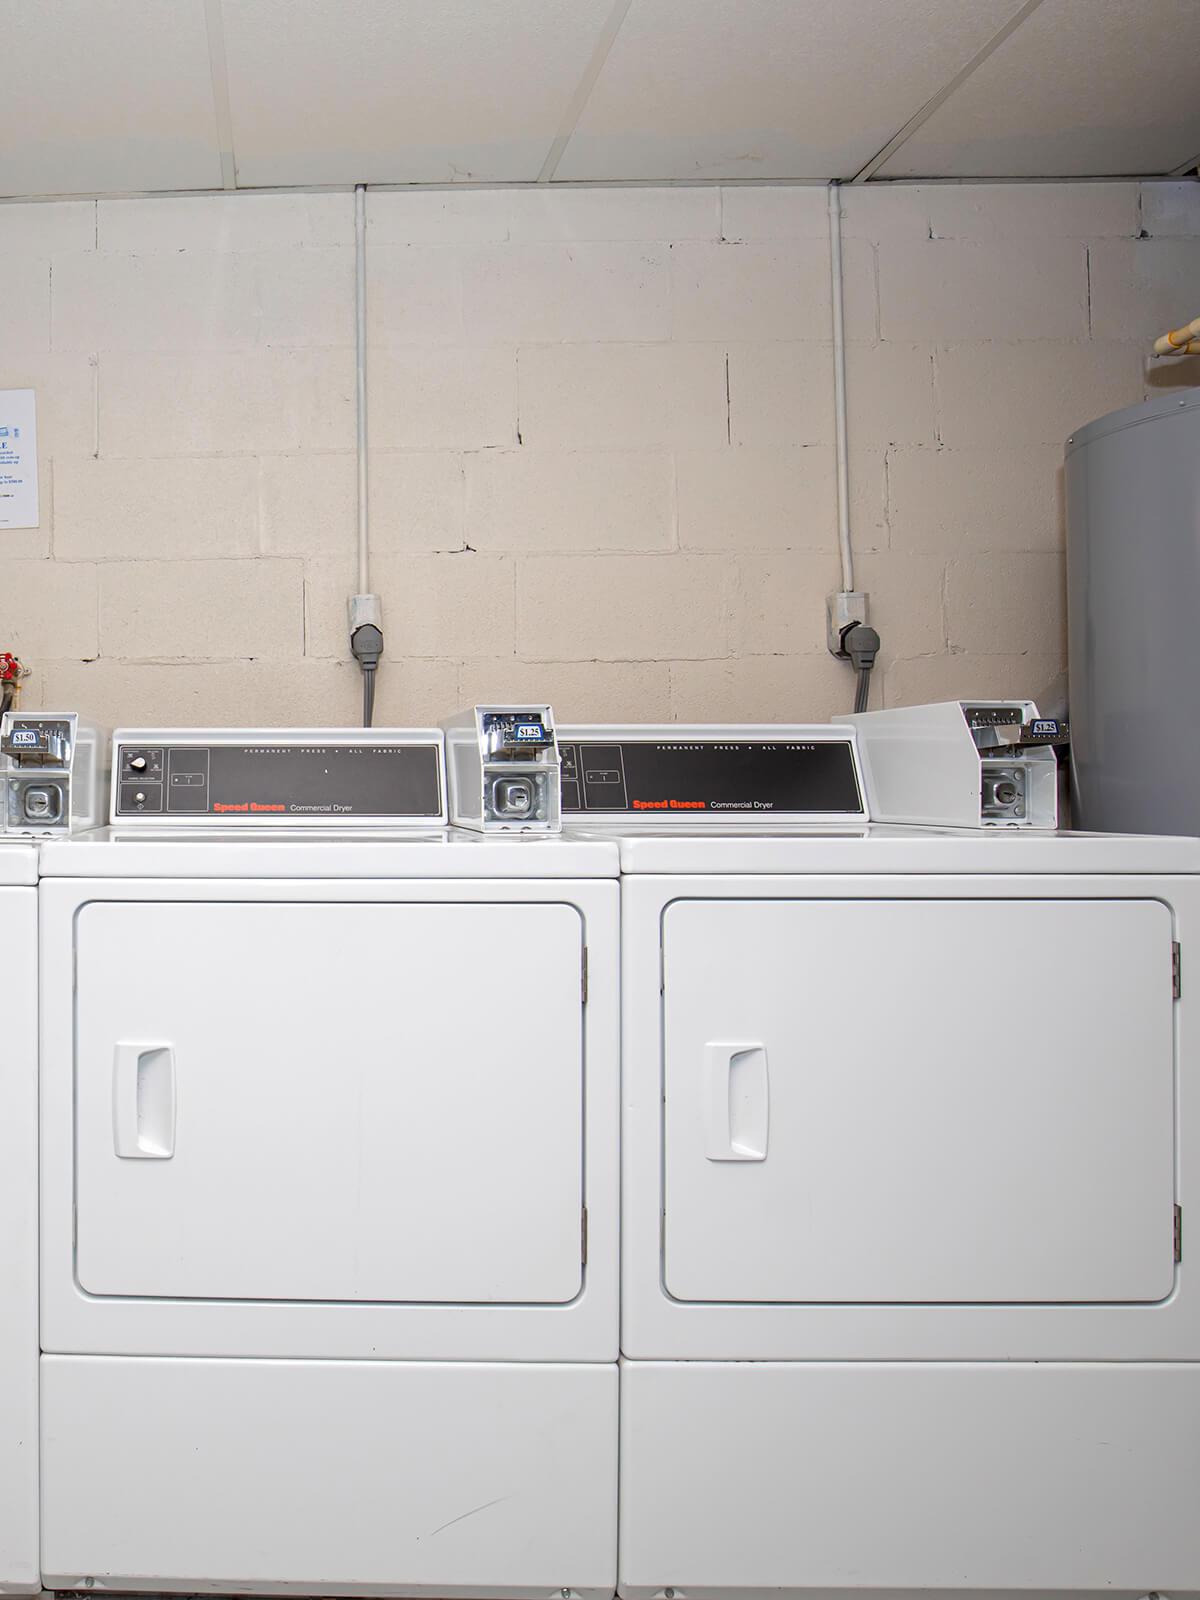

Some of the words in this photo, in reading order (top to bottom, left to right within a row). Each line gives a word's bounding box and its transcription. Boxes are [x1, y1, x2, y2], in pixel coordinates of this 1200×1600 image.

[1036, 723, 1055, 731] $1.25
[520, 728, 539, 737] $1.25
[15, 733, 34, 742] $1.50
[214, 803, 248, 813] Speed
[251, 803, 285, 812] Queen
[290, 804, 332, 812] Commercial
[333, 804, 352, 813] Dryer
[633, 800, 668, 810] Speed
[670, 800, 705, 809] Queen
[710, 801, 752, 809] Commercial
[754, 801, 774, 810] Dryer
